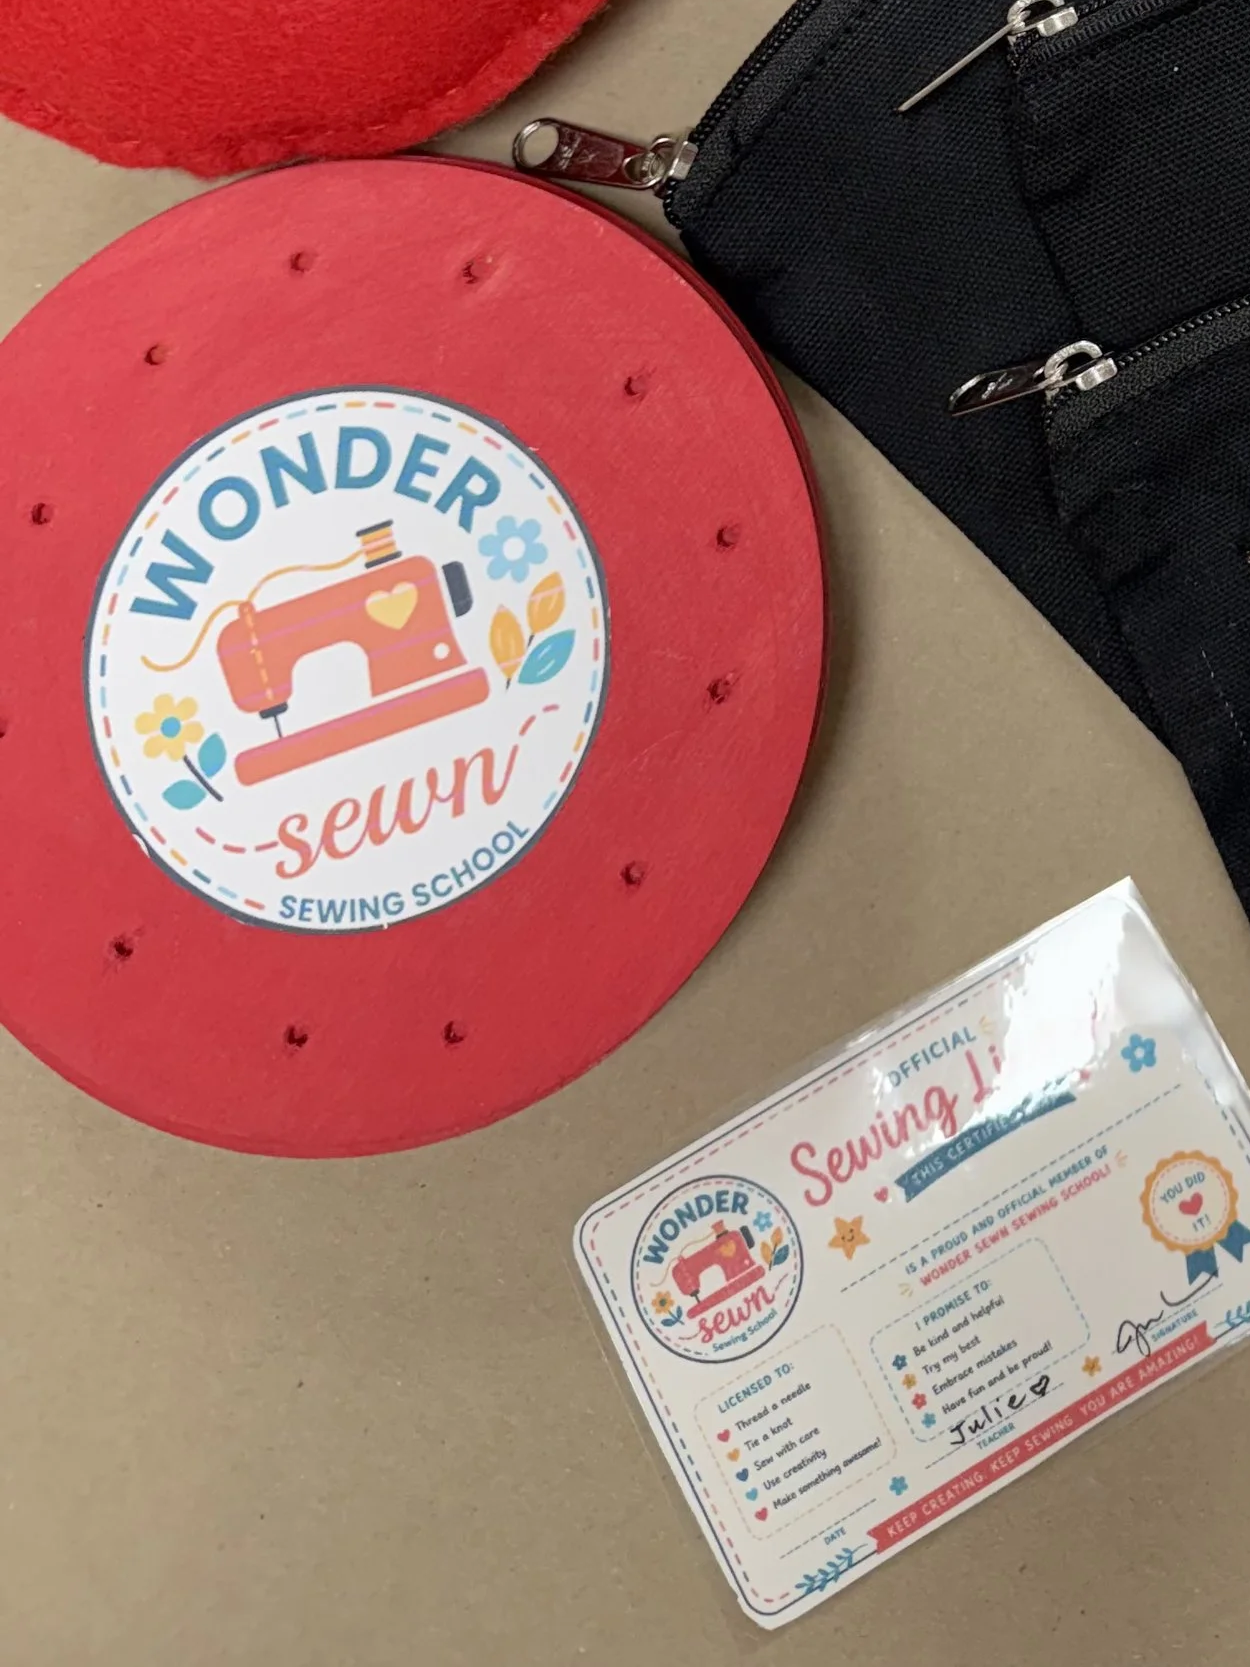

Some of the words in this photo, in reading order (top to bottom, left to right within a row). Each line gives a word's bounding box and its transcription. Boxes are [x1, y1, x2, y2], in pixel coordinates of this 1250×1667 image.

[130, 425, 502, 622] WONDER
[275, 744, 519, 880] sewn
[279, 889, 406, 924] SEWING
[411, 819, 530, 908] SCHOOL
[888, 1025, 977, 1087] OFFICIAL
[790, 1085, 959, 1207] Sewing
[911, 1157, 945, 1186] THIS
[947, 1111, 1019, 1160] CERTIFIE
[905, 1262, 917, 1275] IS
[920, 1255, 930, 1267] A
[930, 1231, 968, 1260] PROUD
[972, 1215, 994, 1235] AND
[997, 1185, 1047, 1219] OFFICIAL
[1048, 1156, 1092, 1187] MEMBER
[1094, 1144, 1109, 1159] OF
[1160, 1182, 1183, 1204] YOU
[1185, 1171, 1206, 1189] DID
[643, 1189, 749, 1265] WONDER
[919, 1249, 972, 1287] WONDER
[974, 1225, 1009, 1255] SEWN
[1011, 1197, 1058, 1231] SEWING
[1060, 1163, 1112, 1202] SCHOOL!
[1192, 1213, 1212, 1232] IT!
[697, 1285, 776, 1343] sewn
[712, 1331, 748, 1352] Sewing
[747, 1308, 778, 1335] School
[913, 1345, 926, 1357] Be
[928, 1329, 950, 1347] kind
[951, 1317, 970, 1333] and
[970, 1294, 1005, 1322] helpful
[923, 1291, 972, 1326] PROMISE
[1151, 1308, 1198, 1342] SIGNATURE
[922, 1363, 941, 1378] Try
[943, 1351, 959, 1365] my
[958, 1335, 981, 1354] best
[931, 1368, 974, 1396] Embrace
[976, 1339, 1018, 1369] mistakes
[941, 1395, 967, 1414] Have
[968, 1384, 986, 1400] fun
[987, 1369, 1006, 1386] and
[1007, 1362, 1020, 1375] be
[1021, 1340, 1053, 1369] proud!
[717, 1375, 773, 1414] LICENSED
[774, 1362, 794, 1378] TO:
[734, 1406, 769, 1431] Thread
[771, 1403, 779, 1411] a
[781, 1382, 812, 1405] needle
[744, 1438, 760, 1451] Tie
[770, 1417, 793, 1436] knot
[887, 1512, 918, 1538] KEEP
[990, 1446, 1021, 1473] KEEP
[1080, 1395, 1106, 1416] YOU
[1109, 1376, 1135, 1399] ARE
[1137, 1335, 1199, 1381] AMAZING!
[950, 1392, 1027, 1445] Julie
[976, 1422, 1017, 1450] TEACHER
[753, 1455, 774, 1471] Sew
[776, 1439, 797, 1458] with
[799, 1427, 820, 1444] care
[763, 1476, 781, 1491] Use
[783, 1448, 828, 1479] creativity
[772, 1492, 797, 1509] Make
[798, 1464, 842, 1495] something
[842, 1437, 882, 1468] awesome!
[823, 1526, 847, 1545] DATE
